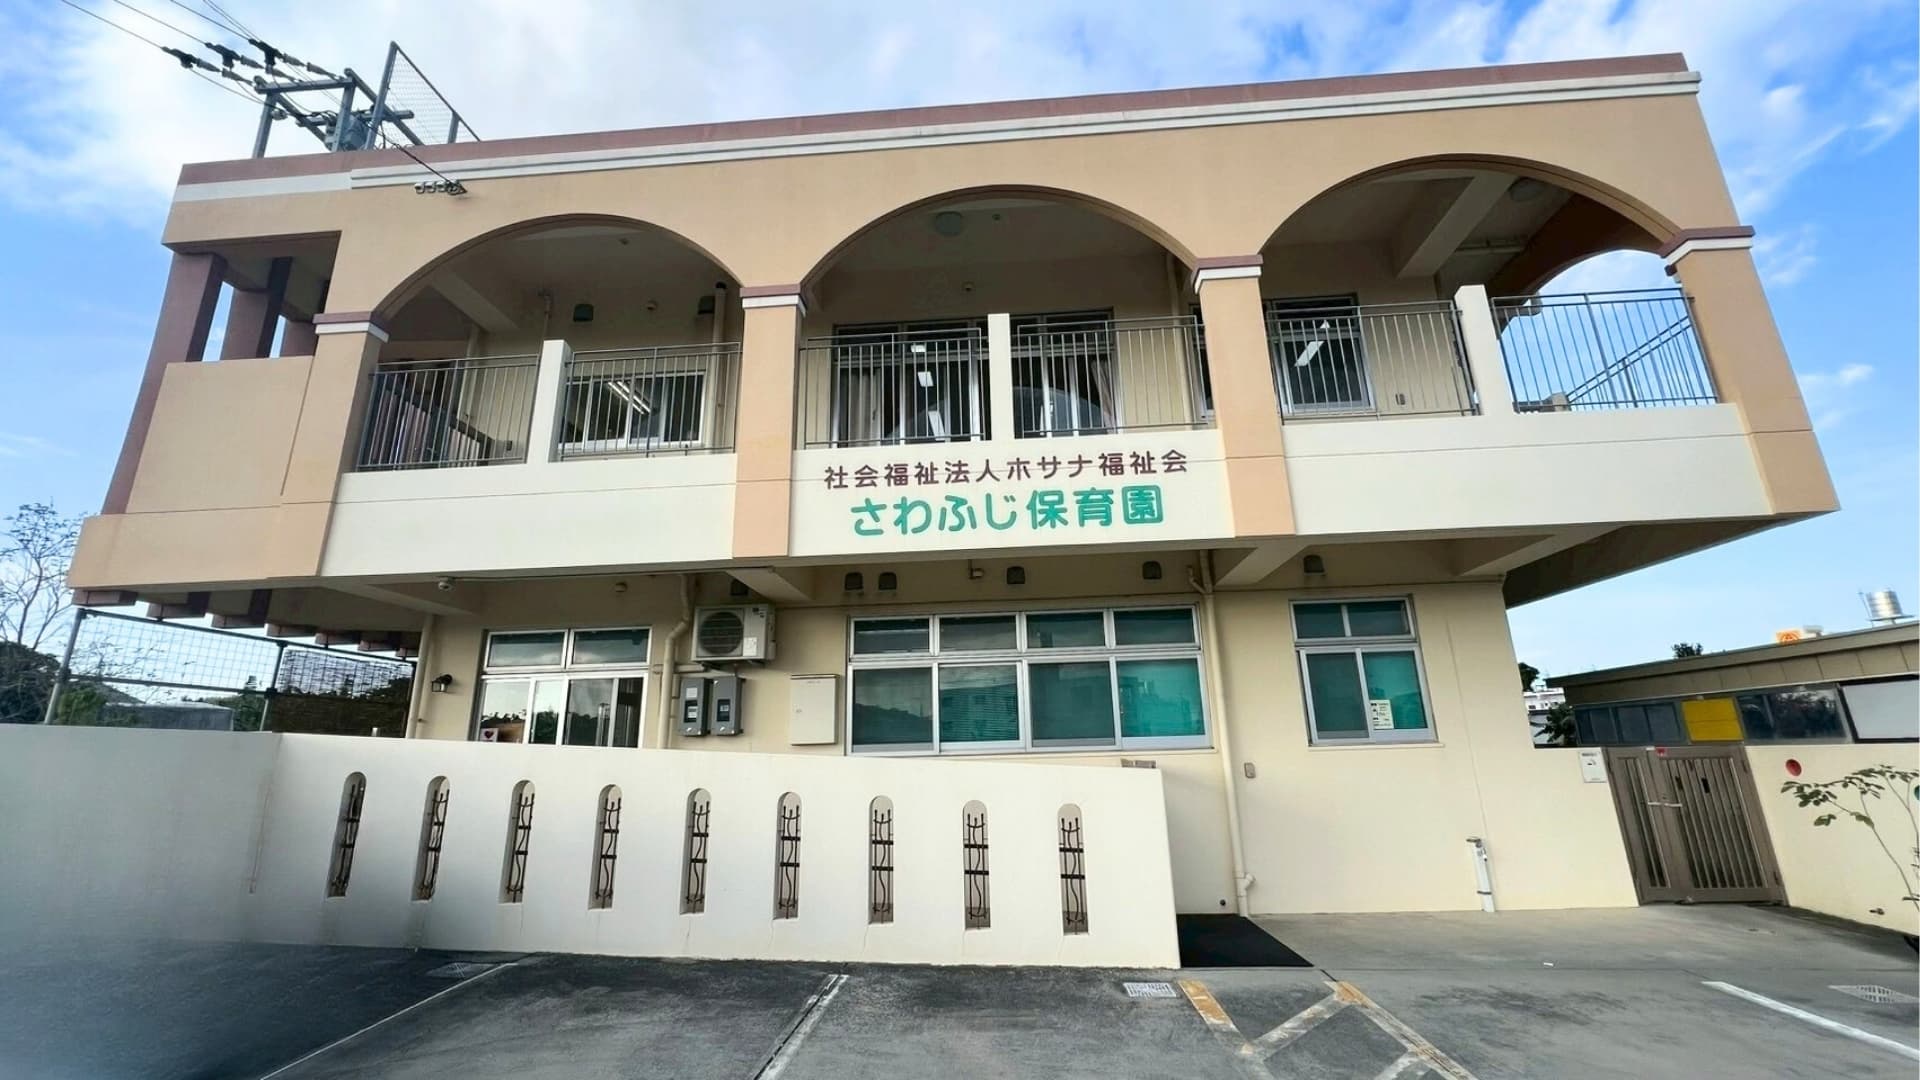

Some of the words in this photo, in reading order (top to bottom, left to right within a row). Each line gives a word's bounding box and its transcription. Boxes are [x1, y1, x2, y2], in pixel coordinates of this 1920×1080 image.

[824, 448, 1188, 490] 社会福祉法人ホサナ福祉会
[851, 484, 1164, 536] さわふじ保育園
